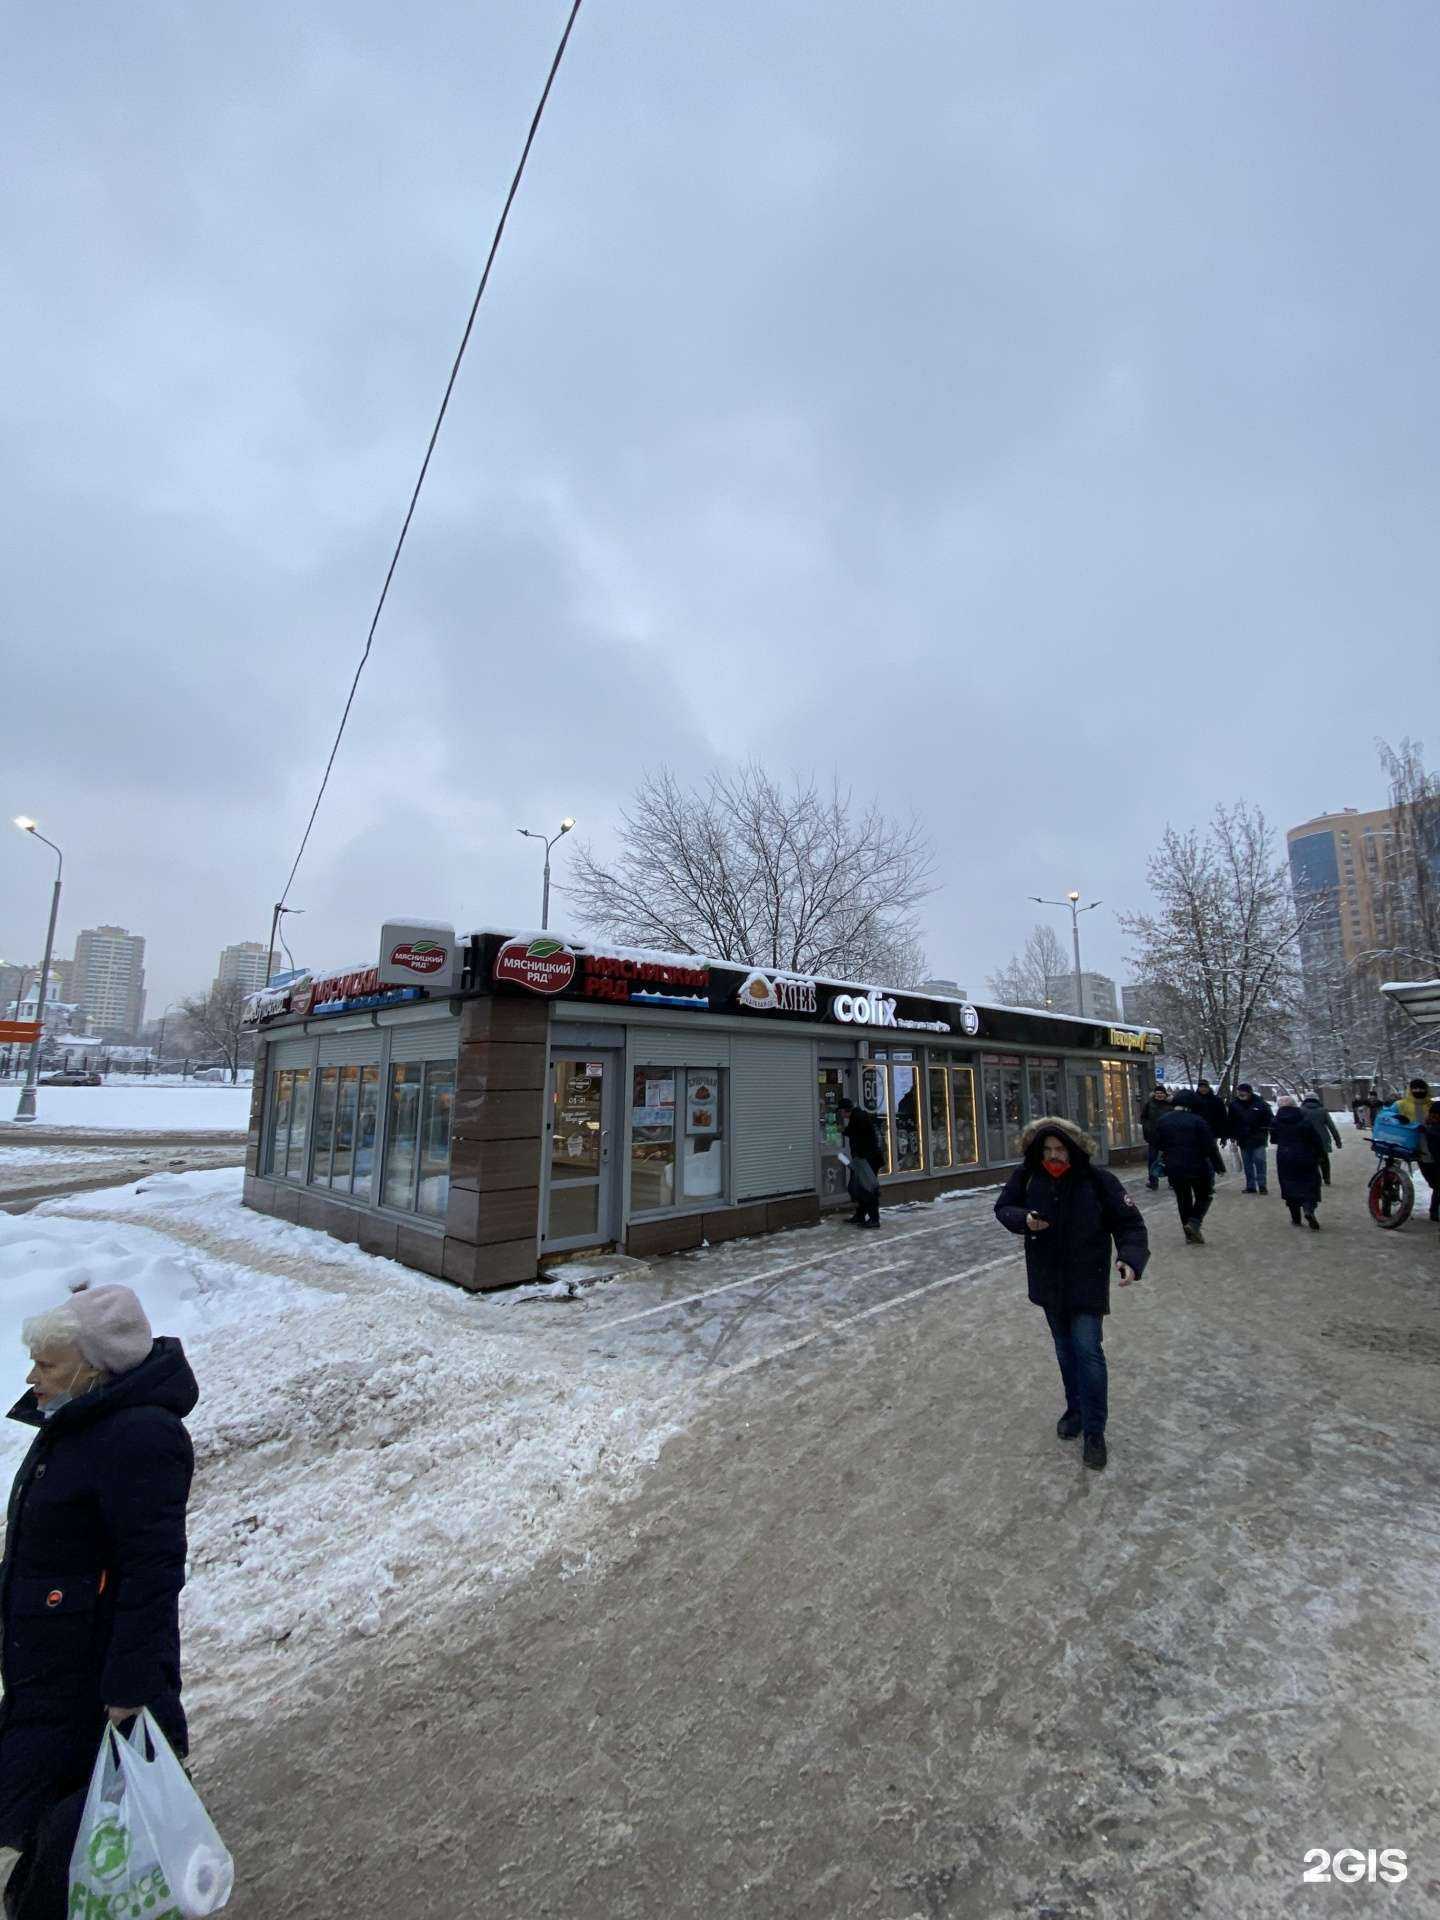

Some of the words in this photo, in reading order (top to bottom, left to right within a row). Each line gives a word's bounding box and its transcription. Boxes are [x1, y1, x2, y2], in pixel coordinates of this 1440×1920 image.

[503, 957, 571, 975] МЯСНИЦКИЙ
[583, 976, 630, 1001] РЯД
[775, 979, 817, 1013] ХЛЕБ
[834, 990, 898, 1028] cofix
